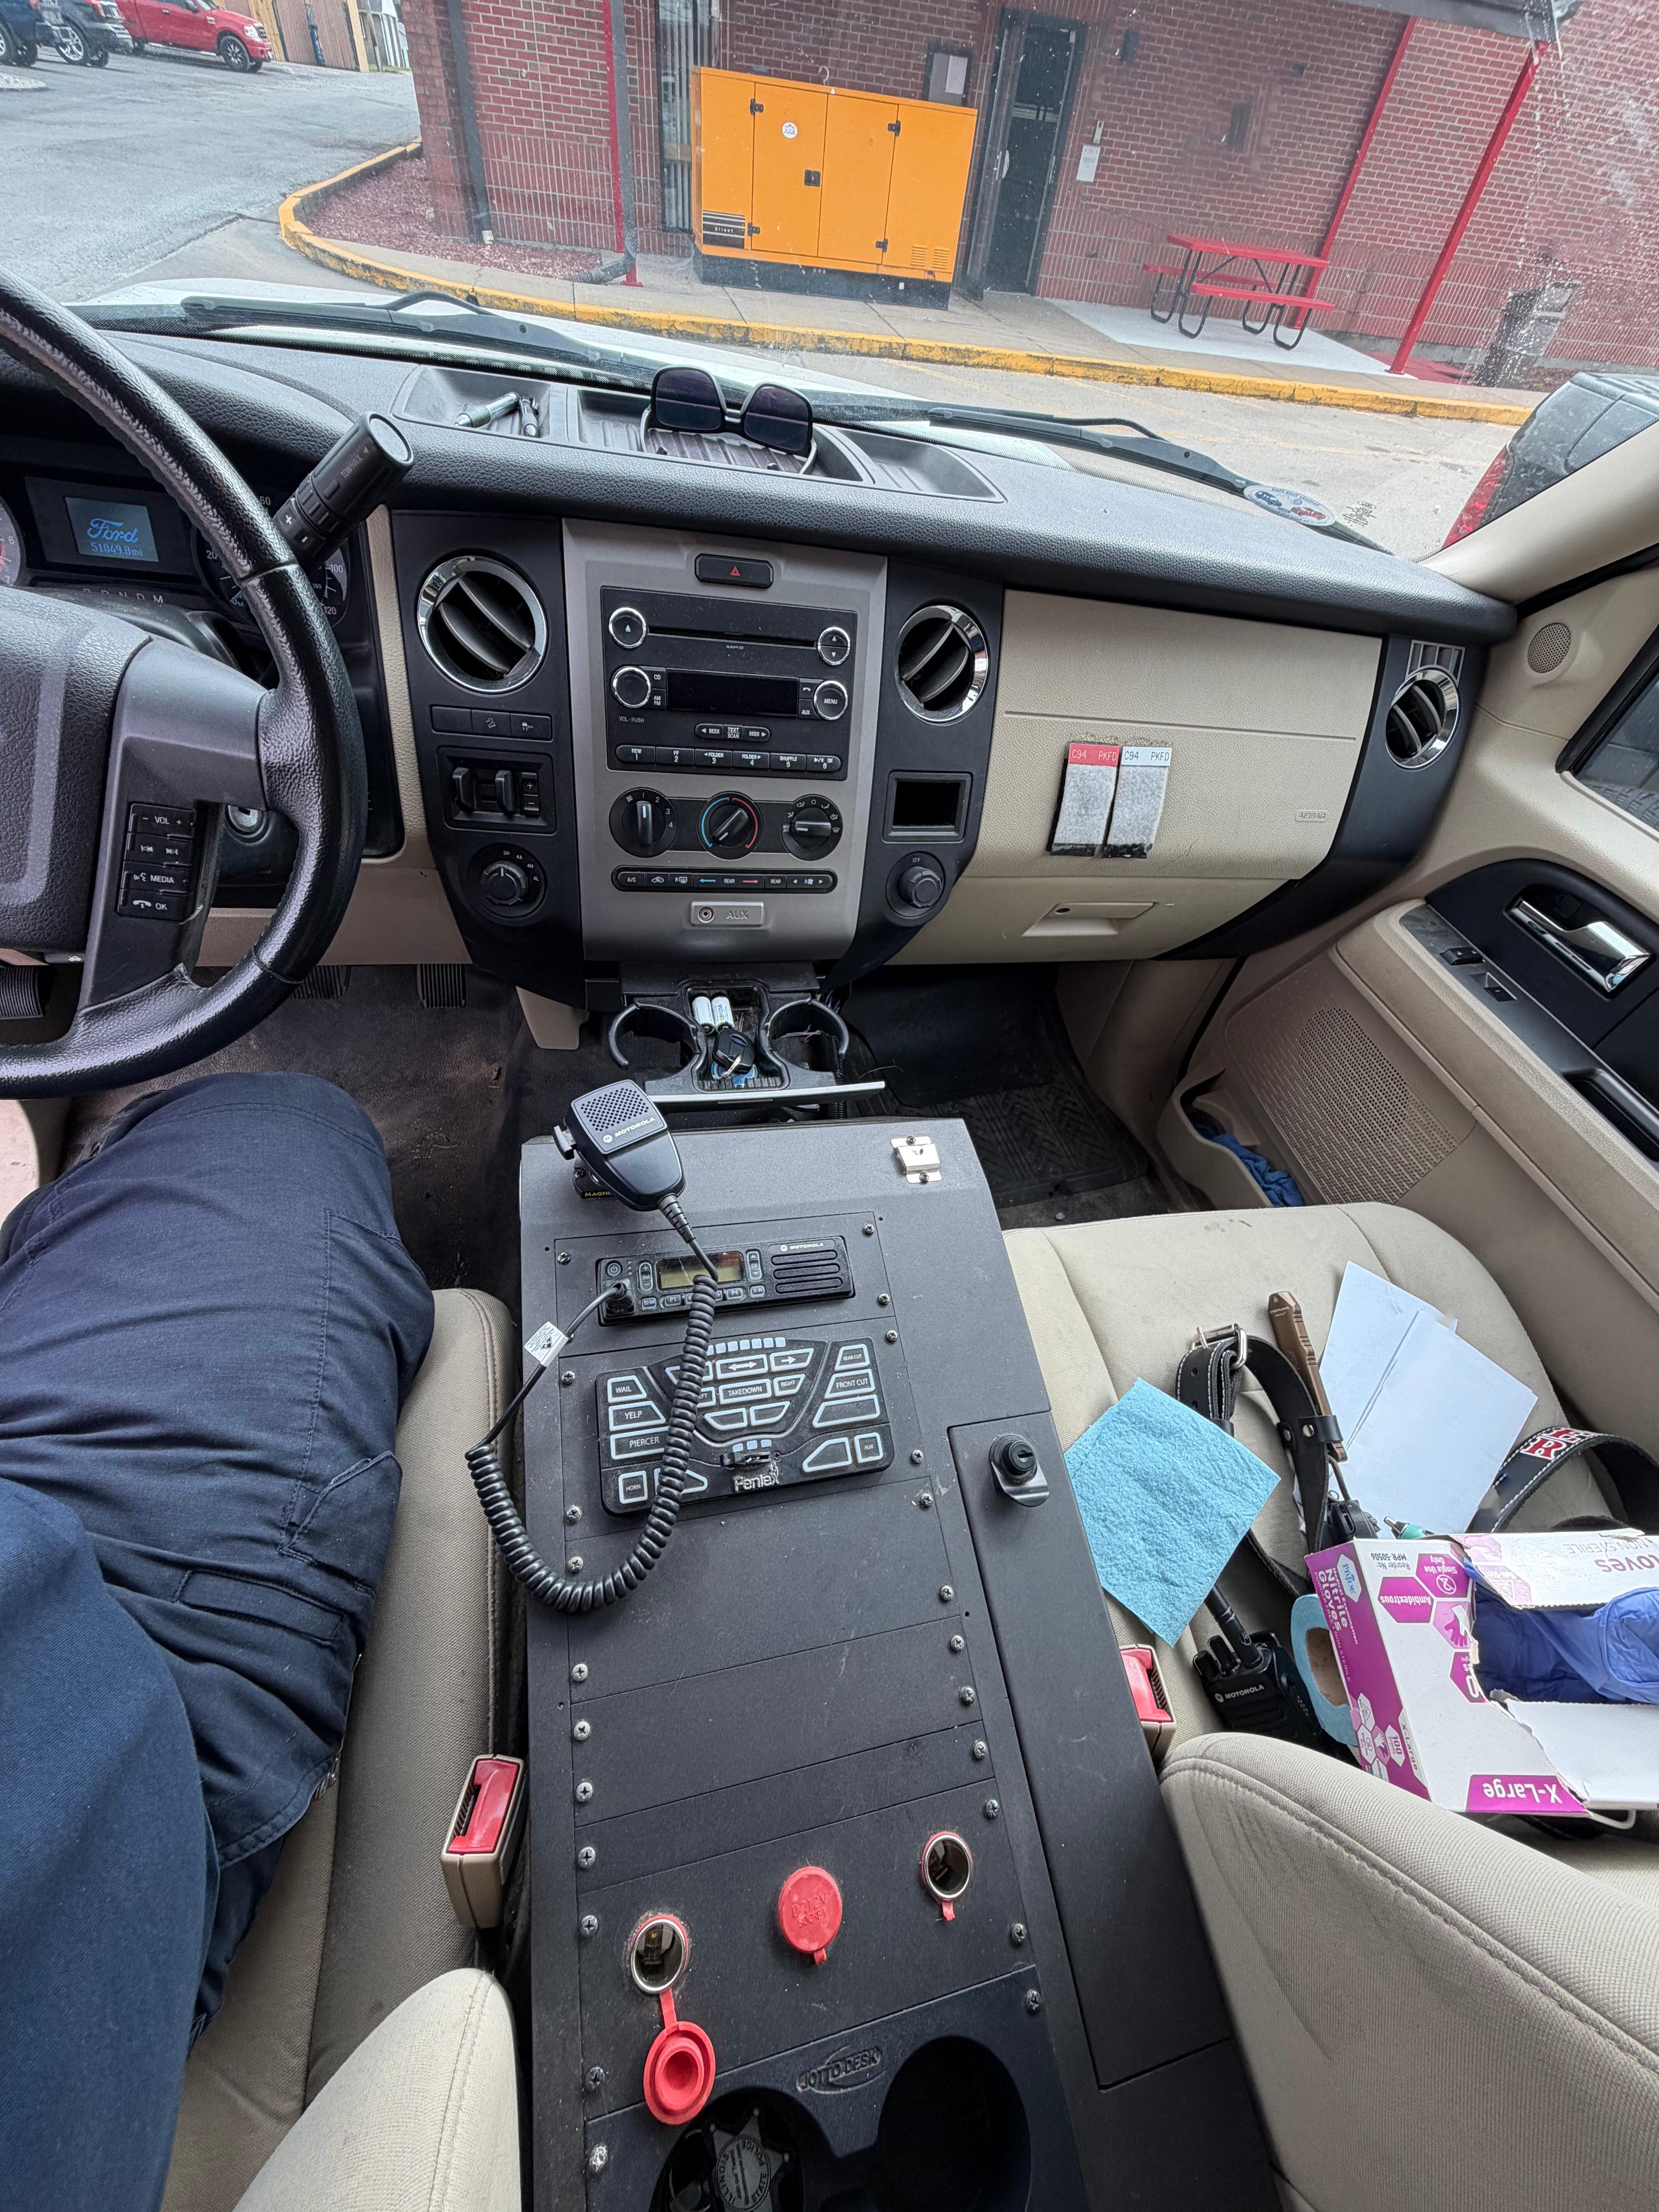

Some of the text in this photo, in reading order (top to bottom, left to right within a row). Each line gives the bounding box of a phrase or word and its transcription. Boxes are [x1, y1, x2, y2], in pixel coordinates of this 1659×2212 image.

[87, 518, 138, 543] Ford
[8, 536, 15, 545] 6
[206, 550, 218, 560] 20
[329, 564, 344, 573] 100
[1072, 749, 1118, 761] C94 PKFD
[1124, 751, 1170, 761] C94 PKFD
[154, 816, 170, 825] VOL
[150, 874, 175, 884] MEDIA
[155, 902, 167, 911] OK
[726, 910, 748, 920] AUX
[614, 1117, 655, 1138] MOTOROLA
[789, 1242, 824, 1250] MOTOROLA
[780, 1379, 795, 1387] RIGHT
[836, 1378, 868, 1389] FRONT CUT
[615, 1385, 632, 1394] WAIL
[727, 1386, 763, 1397] TAKEDOWN
[624, 1411, 643, 1420] YELP
[629, 1436, 660, 1448] PIERCER
[1563, 1538, 1649, 1554] NON STERILE
[1370, 1552, 1407, 1562] MPR-50506
[1429, 1555, 1446, 1566] Only
[1375, 1561, 1411, 1571] Reorder No:
[1423, 1564, 1458, 1575] Single Use
[1318, 1571, 1342, 1632] Gloves
[1325, 1568, 1348, 1628] Nitrile
[1380, 1594, 1432, 1606] Ambidextrous
[1332, 1567, 1359, 1645] Medical Examination
[1314, 1572, 1327, 1603] POWDER
[1333, 1631, 1342, 1648] NON
[1340, 1650, 1351, 1681] STERILE
[1224, 1684, 1265, 1700] MOTOROLA
[1392, 1734, 1402, 1755] 100
[1401, 1723, 1418, 1771] X-Large
[1482, 1778, 1563, 1804] X-Large
[846, 2047, 881, 2074] DESK
